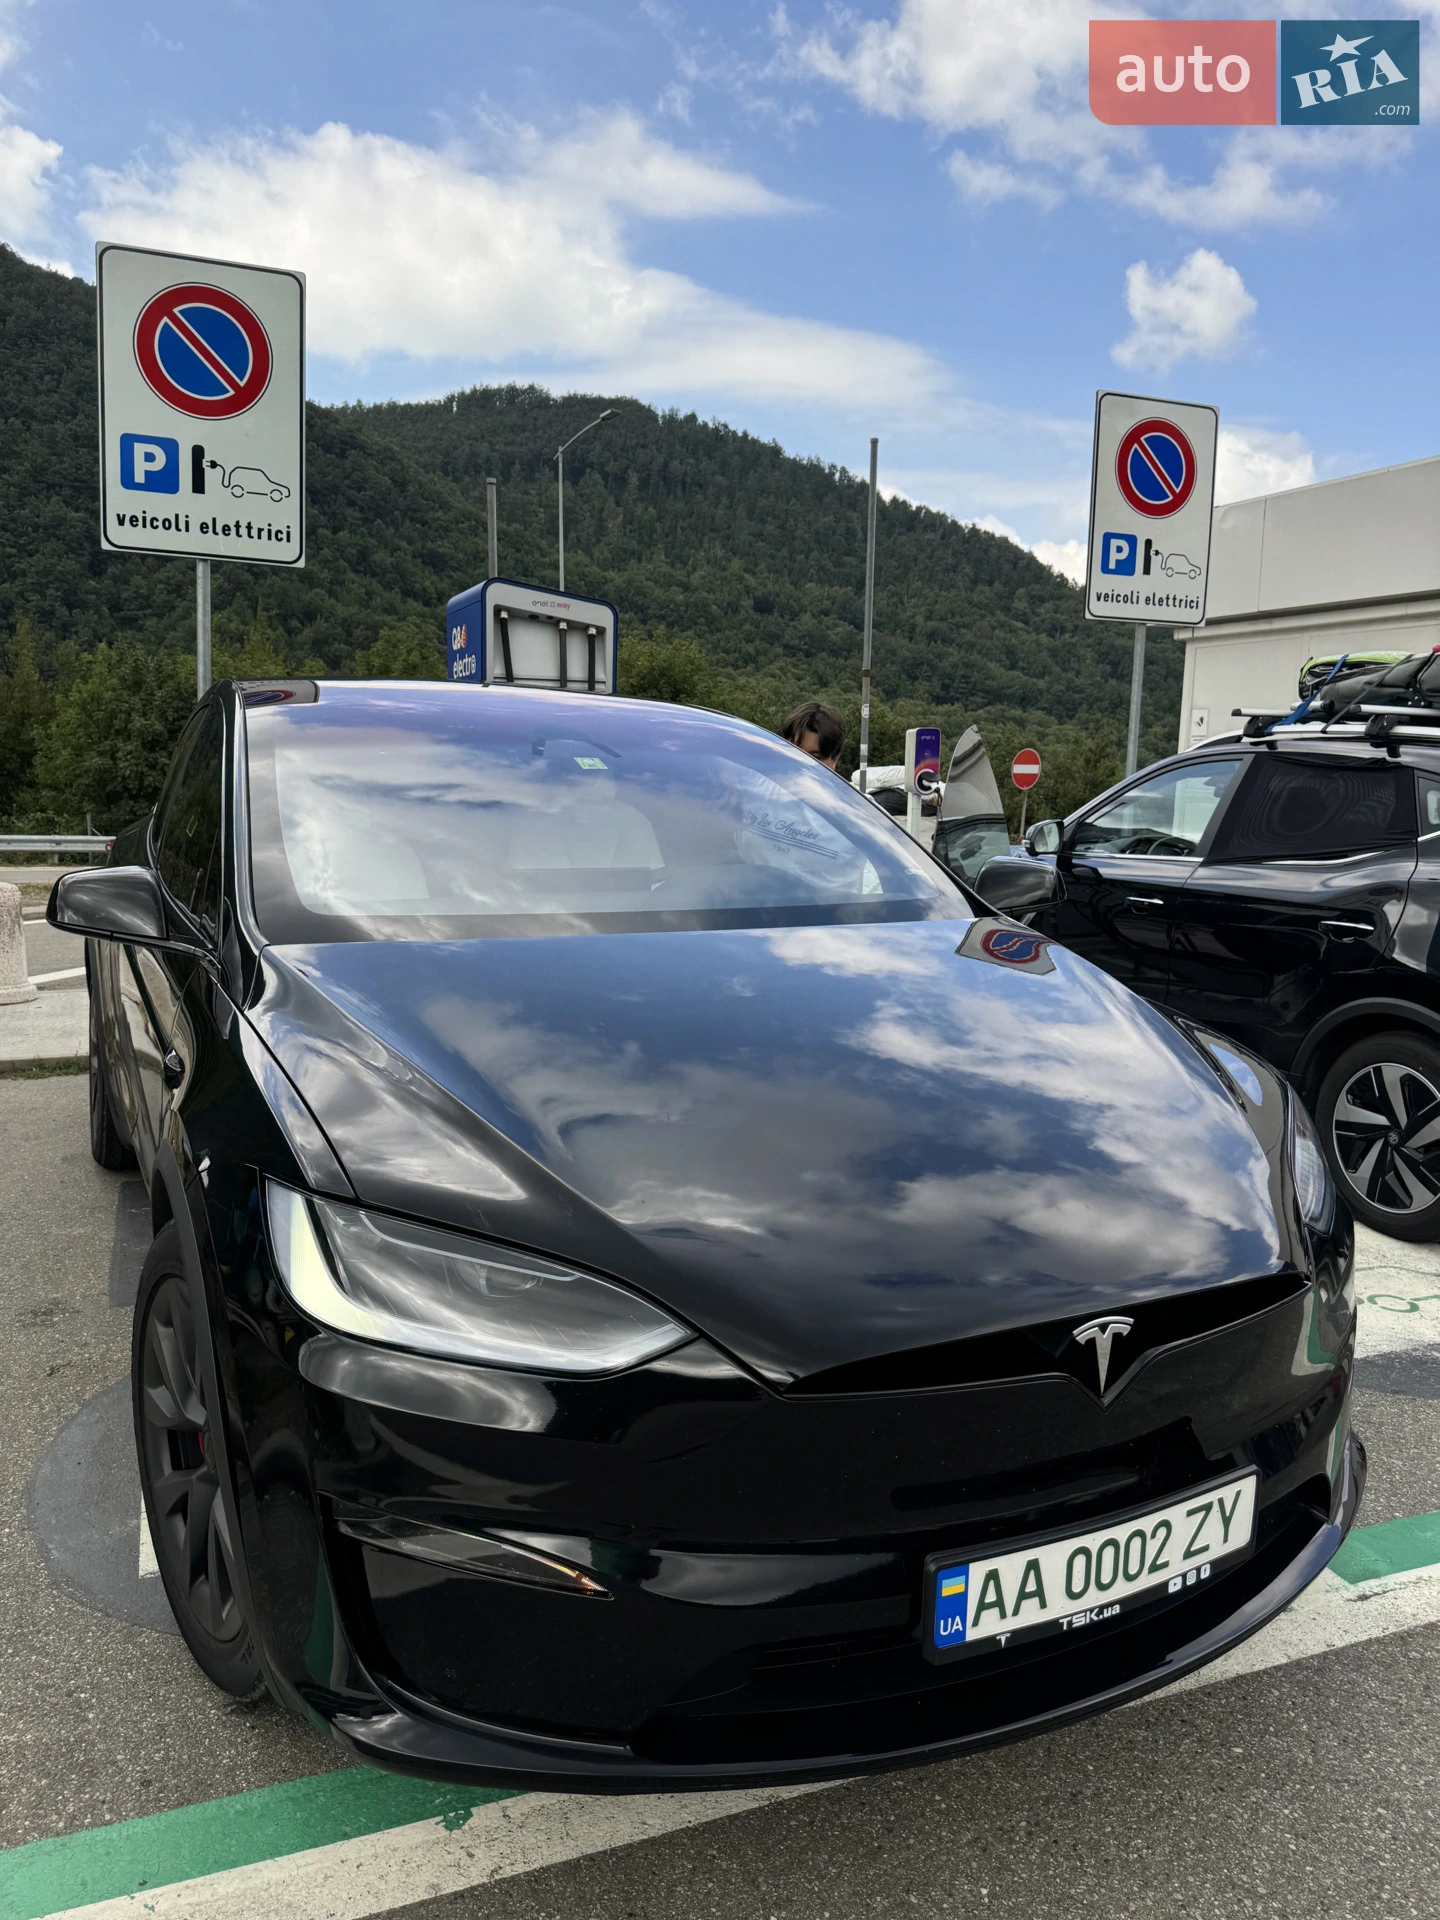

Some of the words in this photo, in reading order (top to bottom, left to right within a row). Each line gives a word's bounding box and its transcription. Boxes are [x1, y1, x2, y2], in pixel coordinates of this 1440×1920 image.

[133, 442, 167, 484] P
[116, 510, 190, 533] veicoli
[199, 517, 292, 543] elettrici
[1108, 538, 1130, 569] P
[557, 602, 571, 610] way
[1096, 589, 1140, 605] veicoli
[1145, 592, 1200, 610] elettrici
[971, 1557, 1048, 1628] AA
[1064, 1518, 1173, 1600] 0002
[1182, 1488, 1242, 1561] ZY
[939, 1615, 964, 1636] UA
